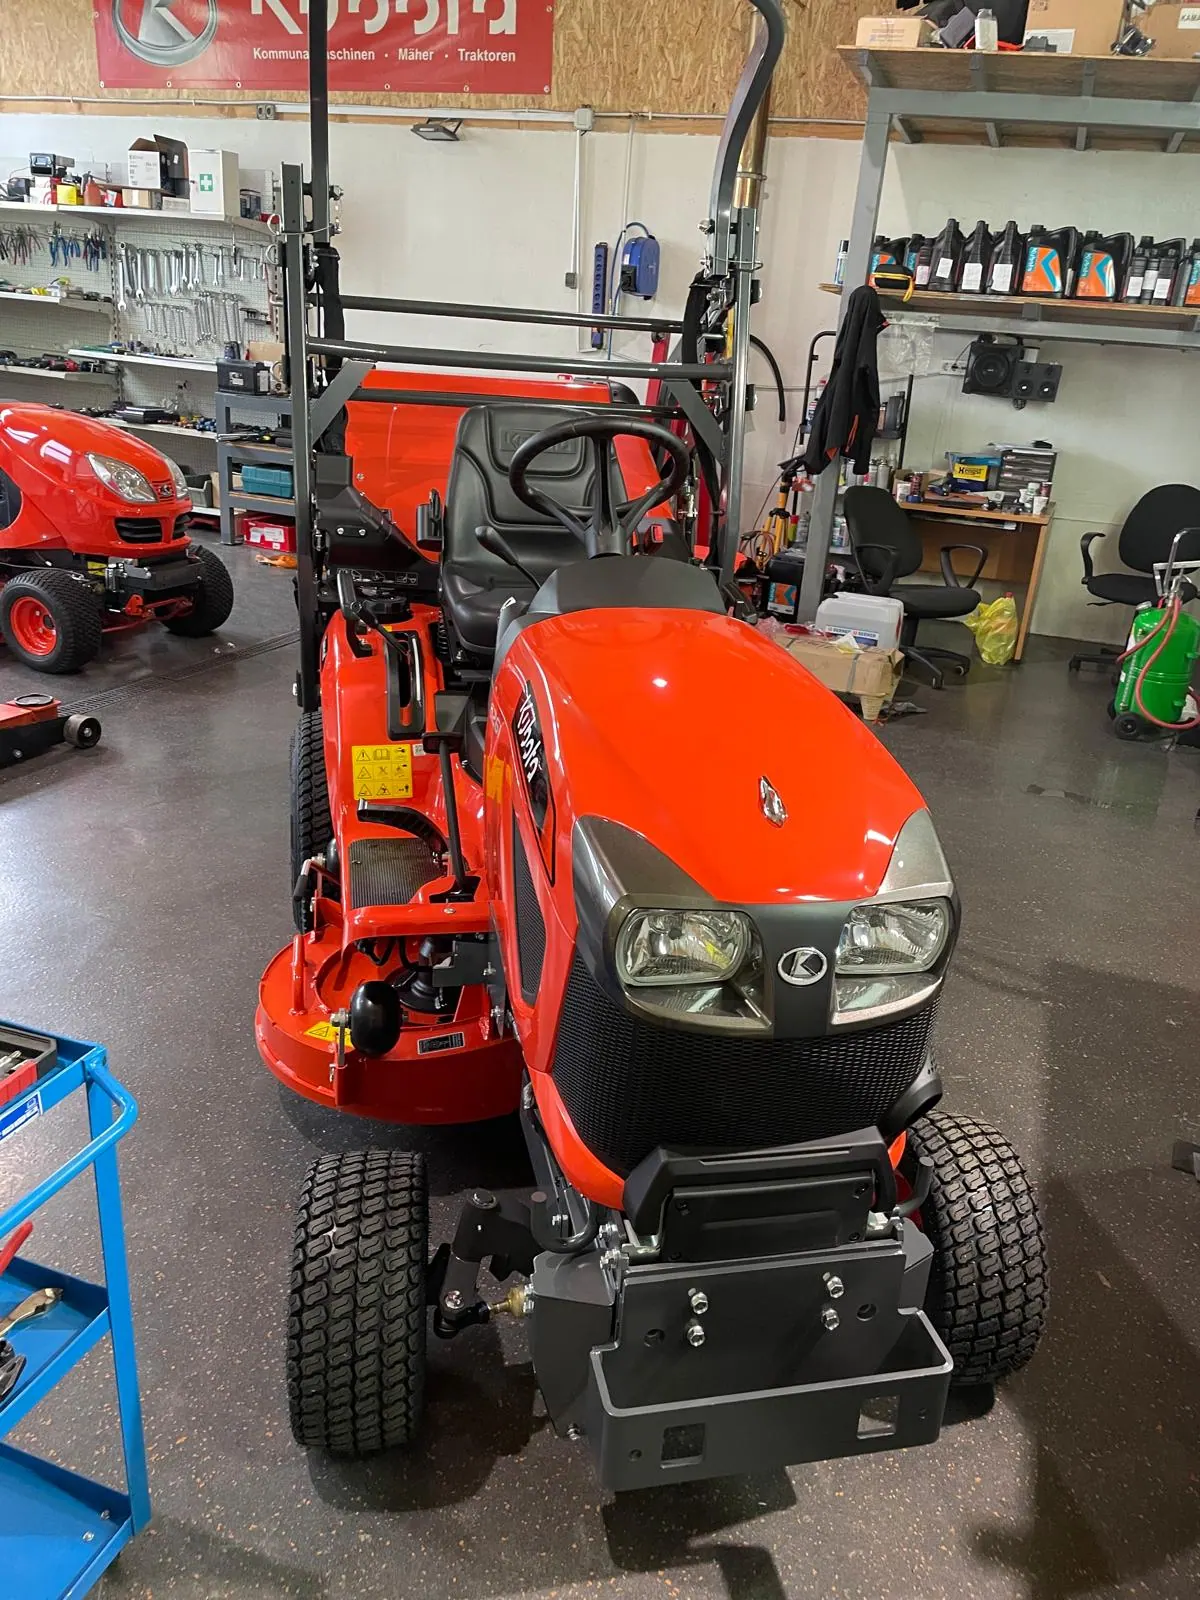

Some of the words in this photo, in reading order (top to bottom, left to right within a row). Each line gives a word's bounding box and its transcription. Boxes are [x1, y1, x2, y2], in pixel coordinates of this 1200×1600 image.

[250, 0, 517, 35] Kbota
[253, 47, 375, 61] Kommunaschinen
[398, 46, 434, 61] Mäher
[458, 48, 516, 62] Traktoren
[517, 694, 541, 783] Kubota
